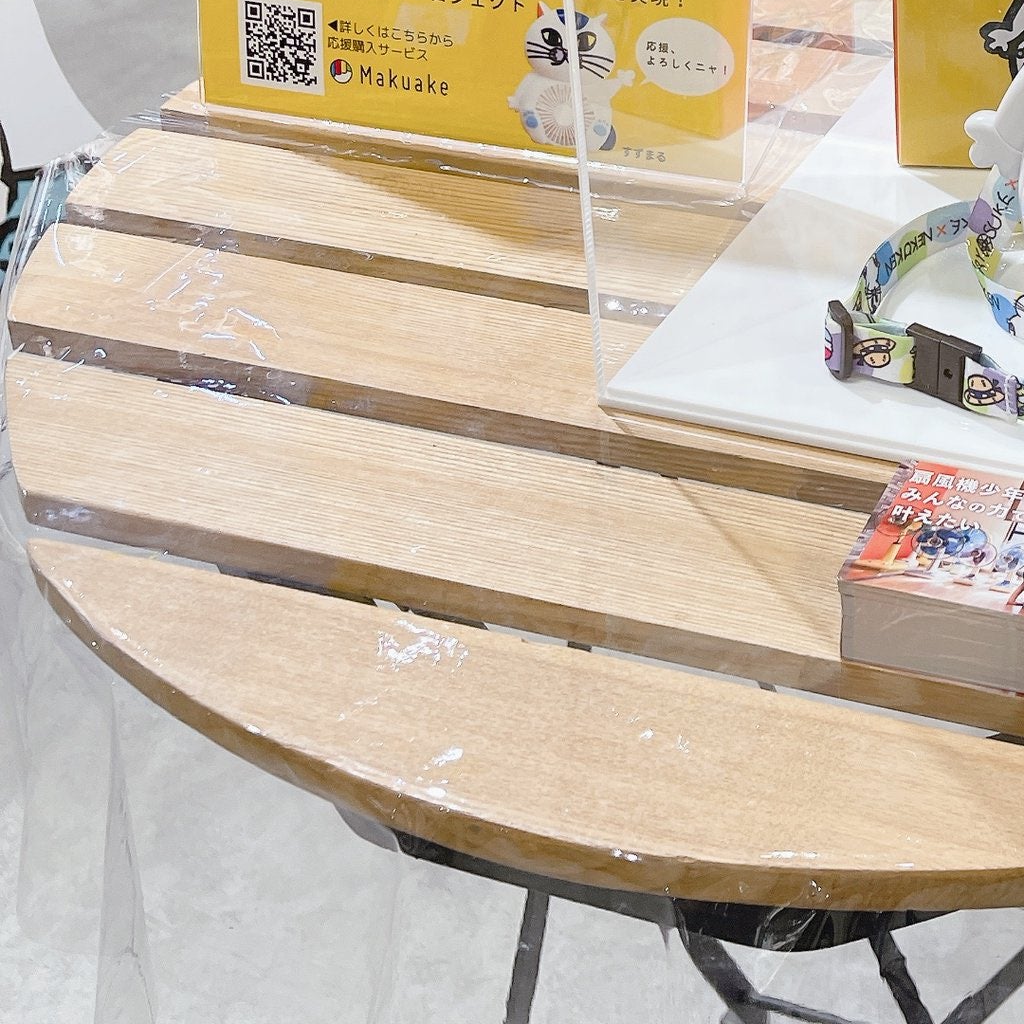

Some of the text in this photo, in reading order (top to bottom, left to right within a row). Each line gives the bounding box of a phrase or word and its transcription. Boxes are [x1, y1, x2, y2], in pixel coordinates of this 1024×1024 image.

[338, 20, 454, 47] 詳しくはこちらから
[327, 37, 428, 62] 応援購入サービス
[359, 64, 449, 97] Makuake
[889, 504, 980, 530] 叶えたい
